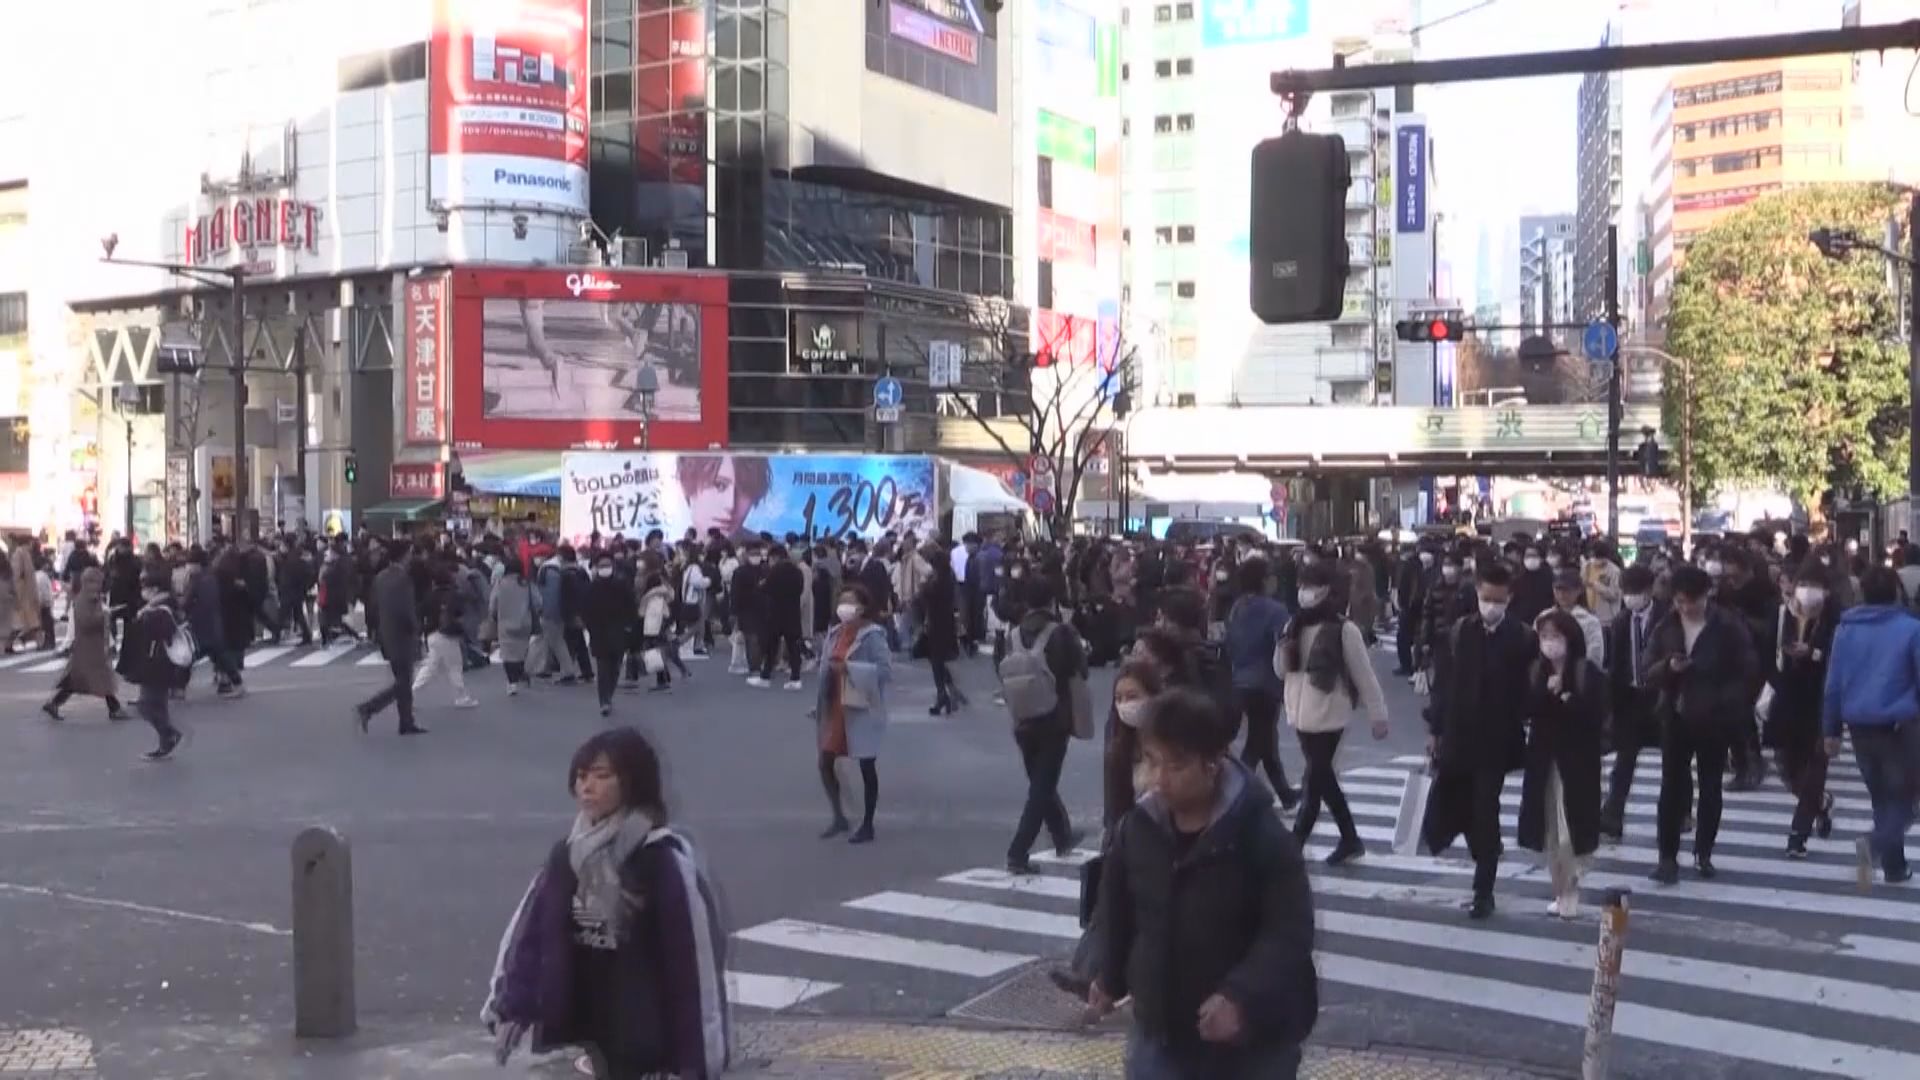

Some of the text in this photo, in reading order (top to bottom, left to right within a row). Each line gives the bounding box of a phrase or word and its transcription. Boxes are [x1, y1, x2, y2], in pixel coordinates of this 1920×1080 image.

[940, 29, 972, 59] NETFLIX
[494, 168, 571, 191] Panasonic
[186, 199, 320, 266] MAGNET
[415, 304, 436, 436] 天津甘栗
[802, 349, 847, 361] COFFEE
